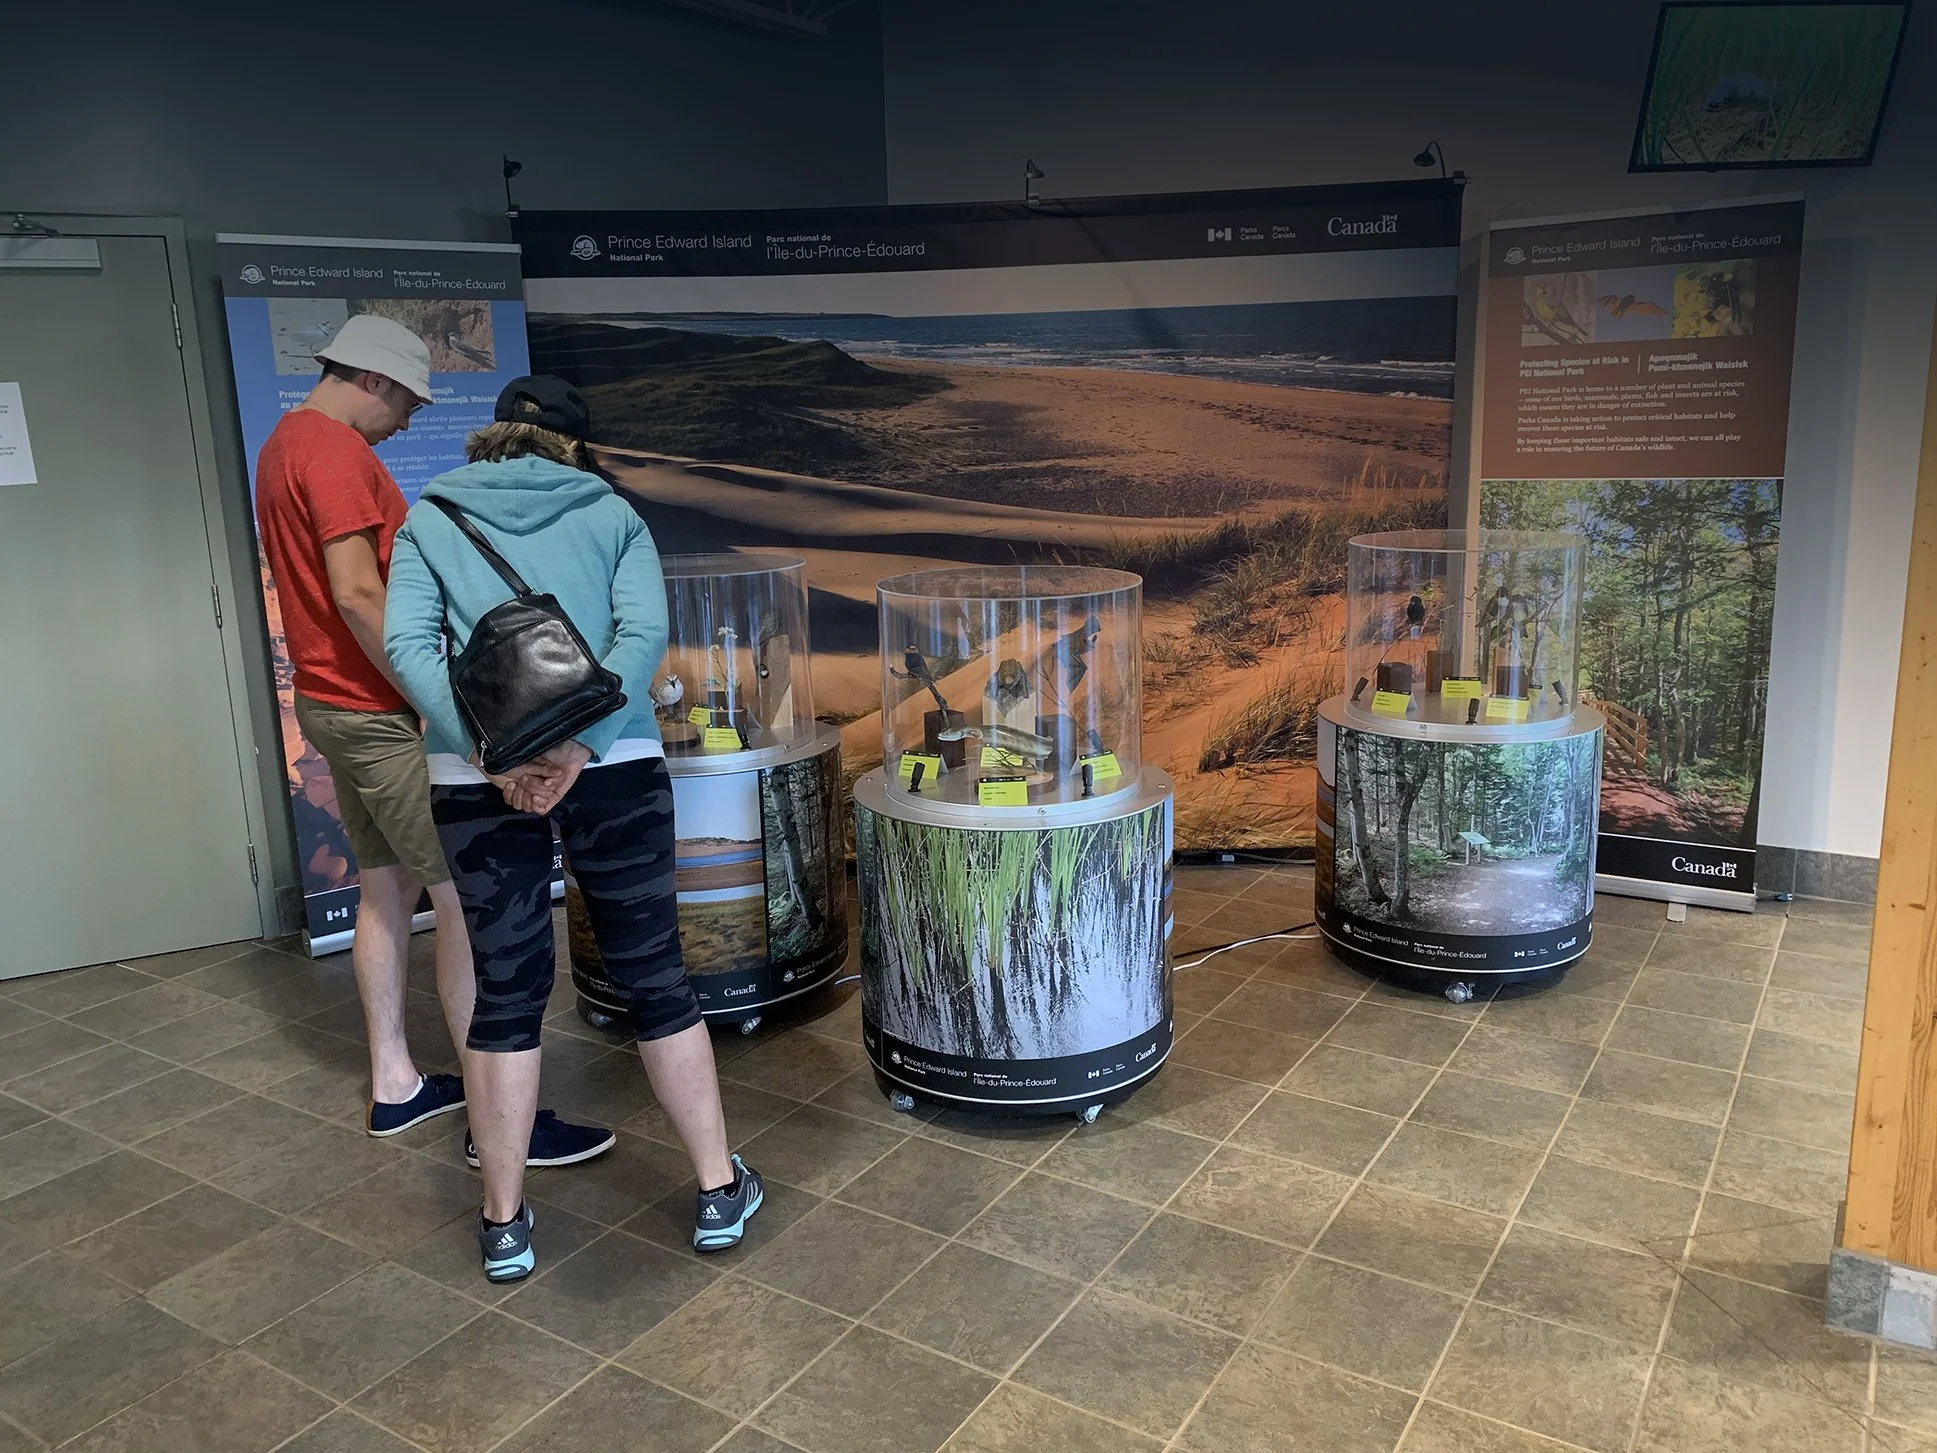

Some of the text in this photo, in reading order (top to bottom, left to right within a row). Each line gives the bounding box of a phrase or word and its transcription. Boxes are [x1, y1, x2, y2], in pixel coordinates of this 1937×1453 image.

[1240, 226, 1257, 234] Parks
[1328, 214, 1397, 236] Canada
[608, 235, 751, 249] Prince Edward Island
[766, 235, 784, 243] Parc
[822, 234, 832, 242] de
[767, 241, 925, 259] l'Île-du-Prince-Édouard
[1532, 237, 1640, 255] Prince Edward Island
[610, 254, 642, 262] National
[270, 265, 383, 278] Prince Edward Island
[1520, 360, 1558, 368] Protecting
[1561, 358, 1590, 367] Species
[1602, 356, 1620, 364] Risk
[1520, 368, 1584, 378] PEI National Park
[428, 387, 455, 395] nmujik
[1657, 382, 1675, 391] plant
[1719, 380, 1745, 388] species
[1597, 402, 1621, 410] danger
[1622, 414, 1647, 422] protect
[1674, 412, 1702, 420] habitats
[1719, 411, 1736, 419] help
[1561, 424, 1584, 432] species
[1527, 437, 1552, 445] keeping
[1572, 436, 1605, 444] important
[1726, 434, 1741, 442] play
[1544, 445, 1572, 453] ensuring
[1672, 856, 1737, 878] Canada
[904, 1056, 921, 1068] Prince
[922, 1062, 945, 1074] Edward
[947, 1067, 967, 1077] Island
